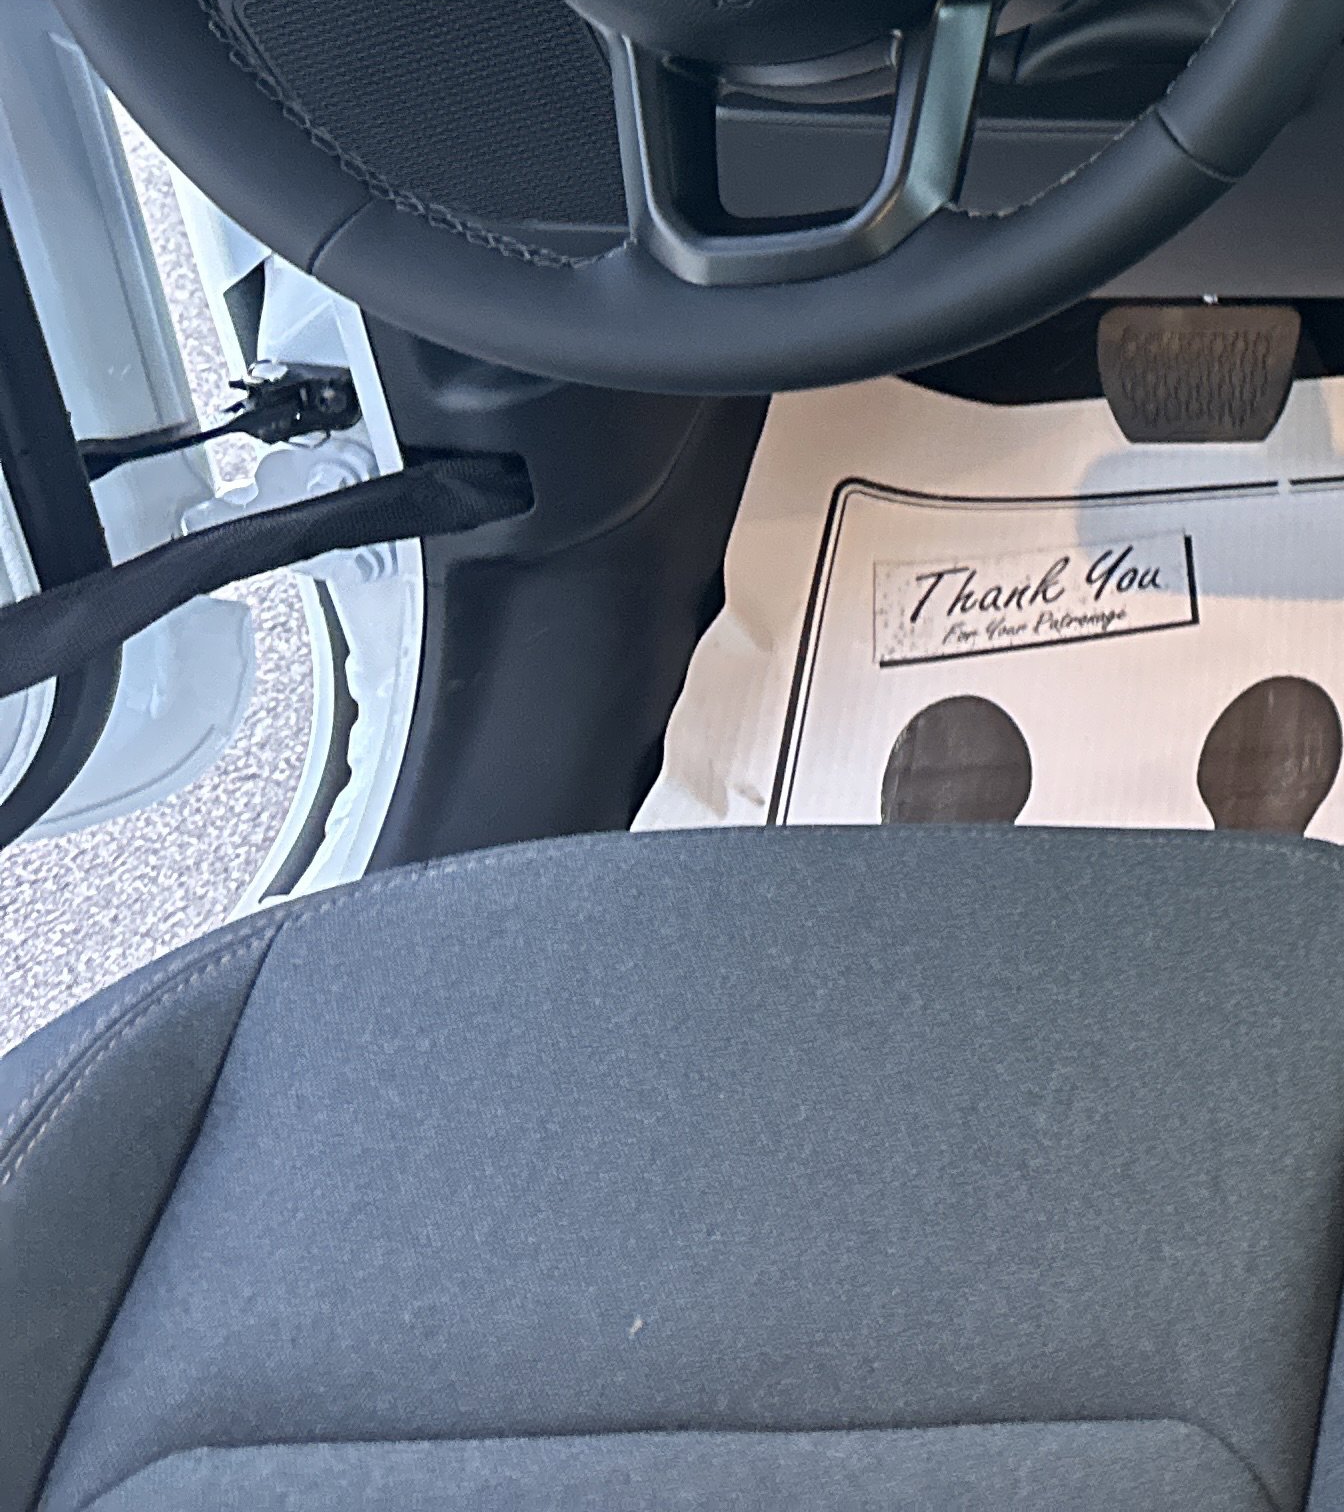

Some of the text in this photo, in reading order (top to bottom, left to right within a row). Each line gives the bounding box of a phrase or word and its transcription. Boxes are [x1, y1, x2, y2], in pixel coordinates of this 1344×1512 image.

[909, 544, 1163, 625] Thank You
[942, 621, 978, 645] For
[984, 616, 1028, 641] Your
